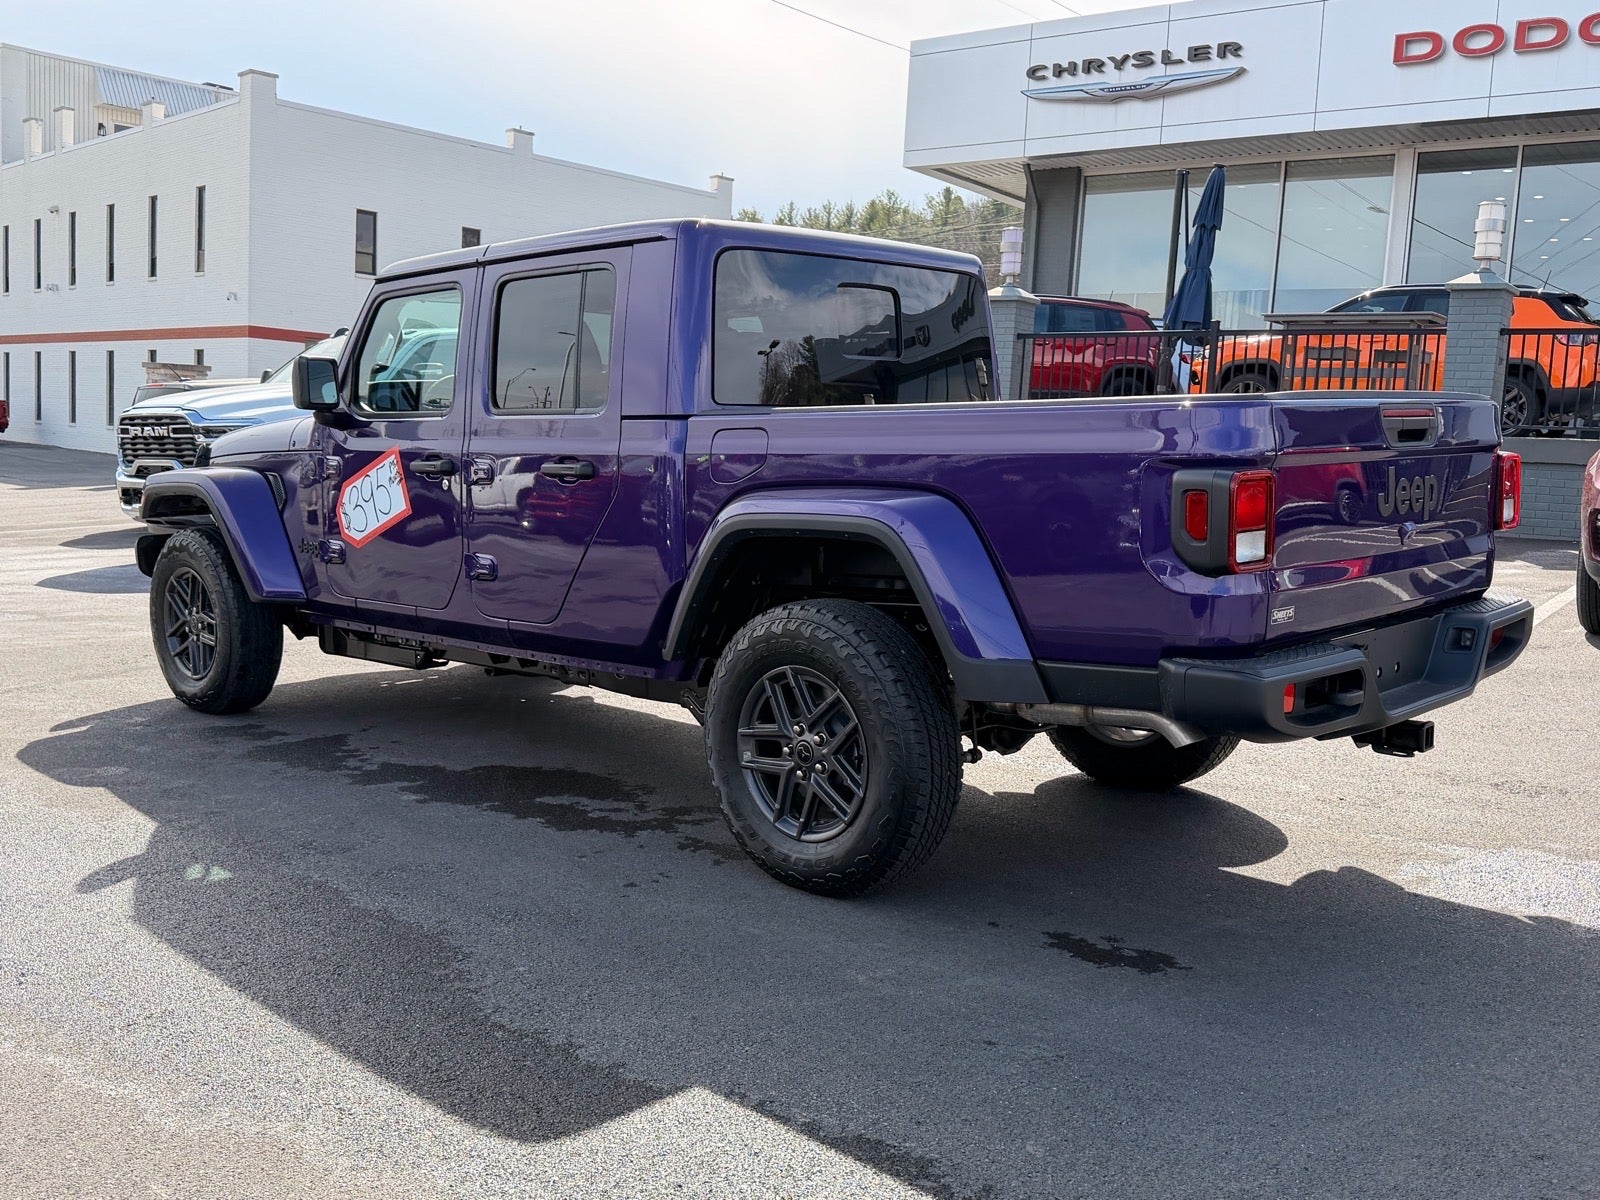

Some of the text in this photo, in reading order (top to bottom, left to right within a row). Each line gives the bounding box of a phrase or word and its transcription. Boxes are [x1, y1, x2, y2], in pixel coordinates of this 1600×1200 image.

[1026, 41, 1244, 80] CHRYSLER
[1104, 84, 1147, 93] CHRYSLER
[129, 426, 169, 437] RAM
[1378, 466, 1438, 520] Jeep
[299, 538, 320, 558] Jeep
